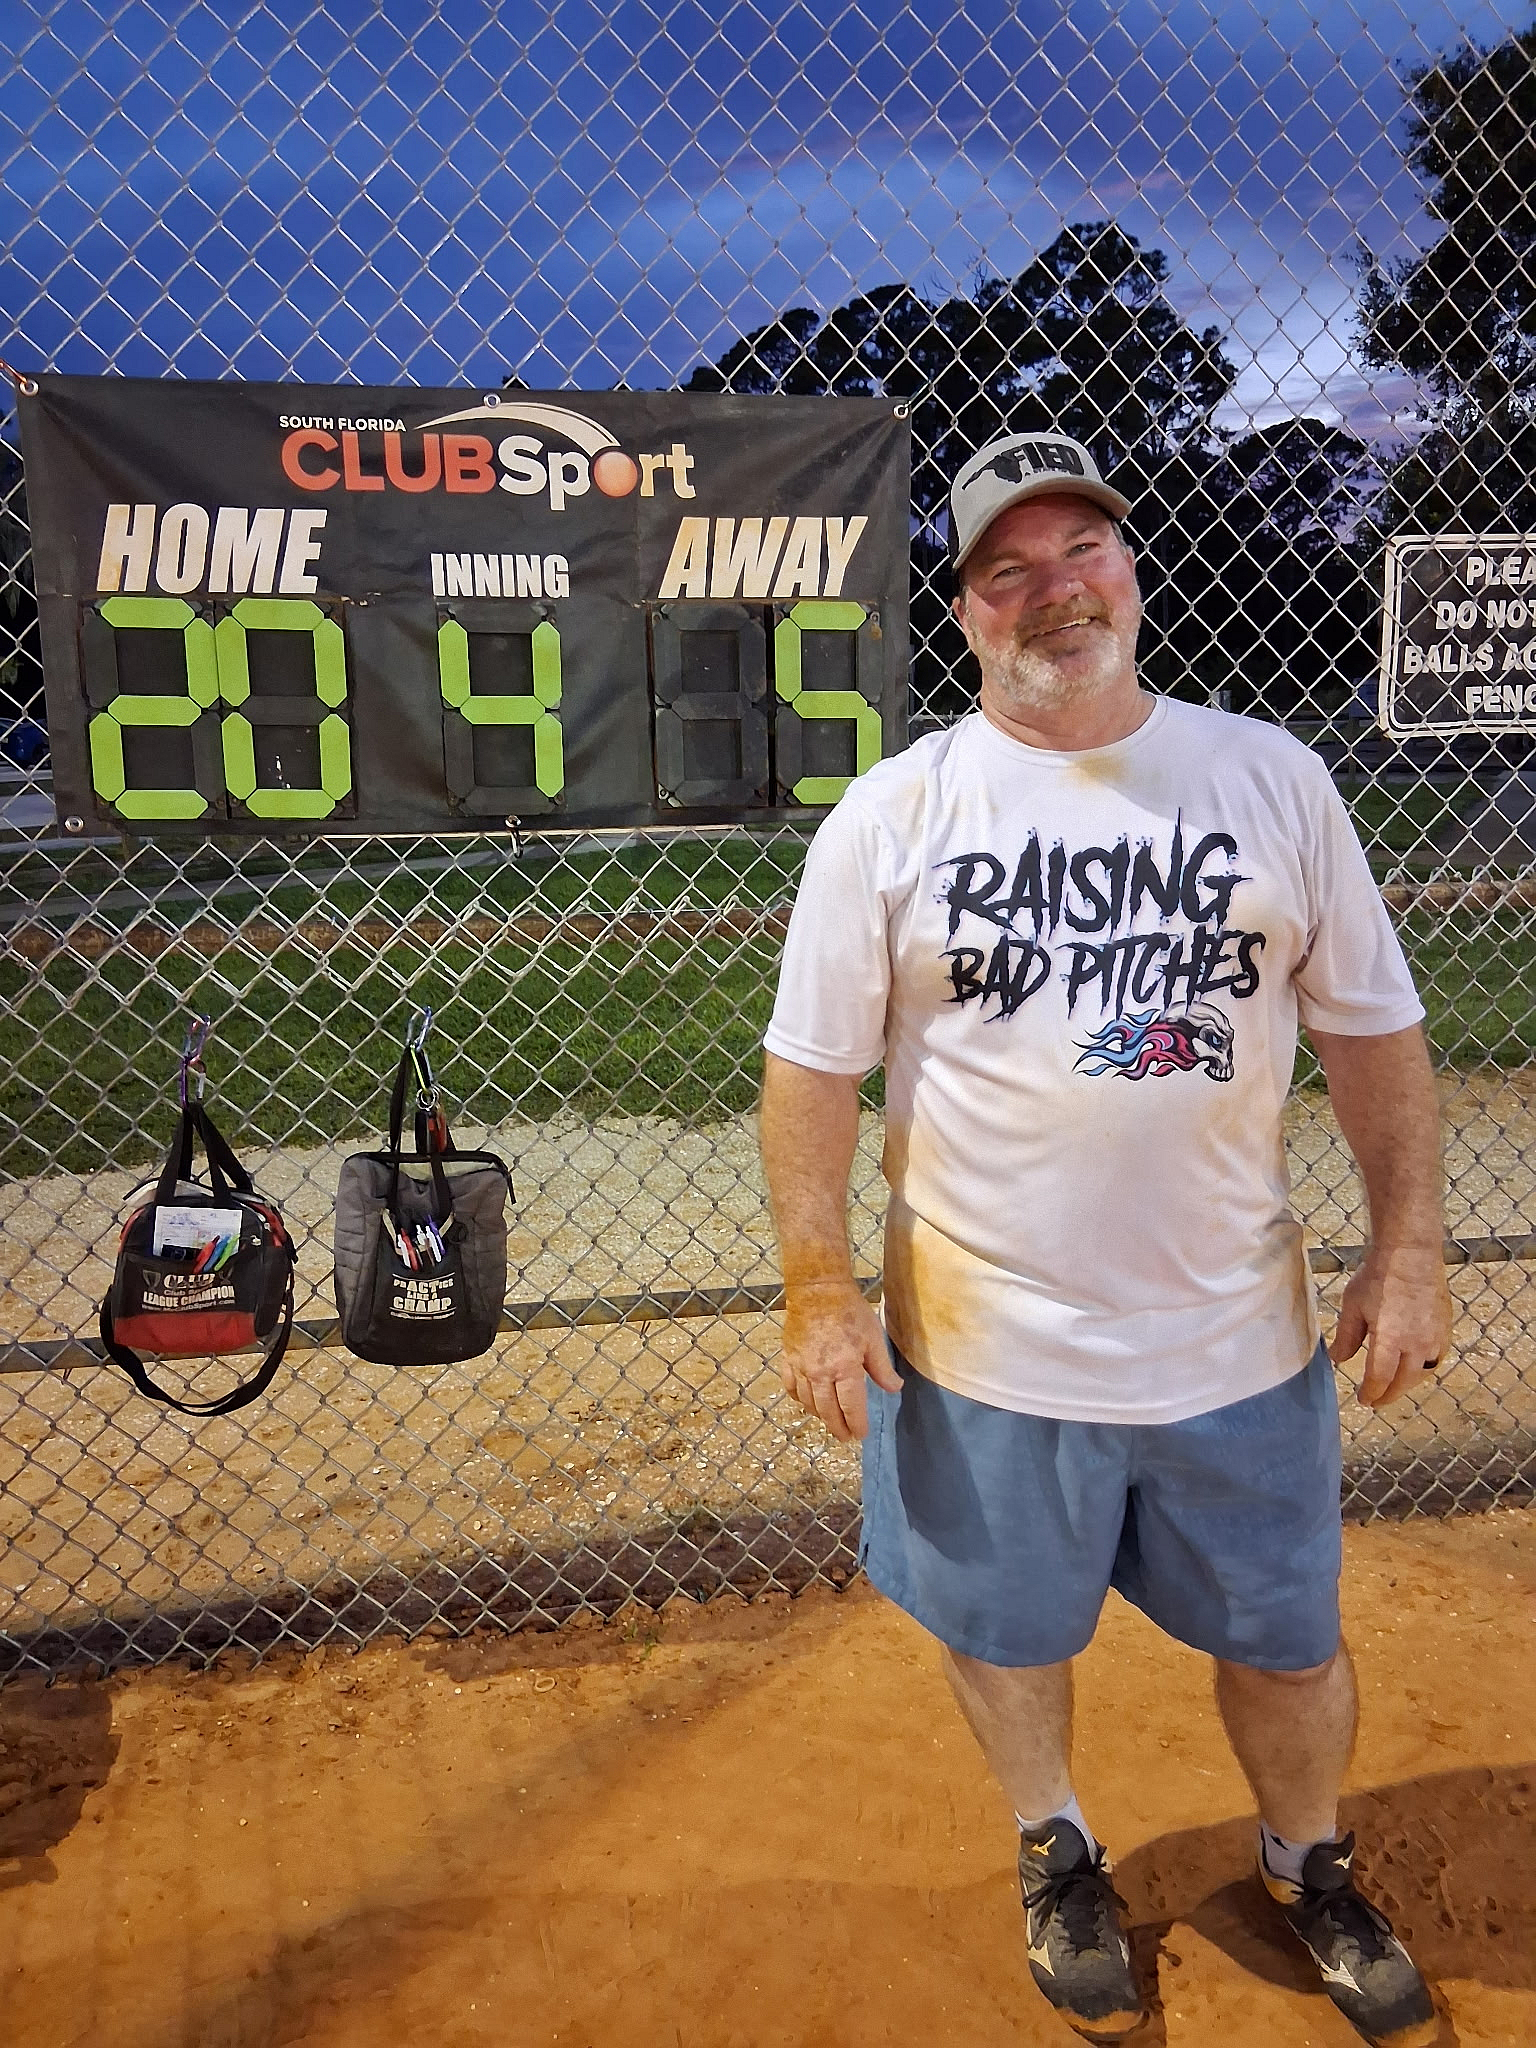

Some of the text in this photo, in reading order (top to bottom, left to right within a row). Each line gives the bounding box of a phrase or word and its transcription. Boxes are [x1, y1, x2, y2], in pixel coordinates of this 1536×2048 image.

[279, 415, 407, 432] SOUTH FLORIDA
[96, 502, 328, 594] HOME
[430, 553, 570, 599] INNING
[658, 516, 869, 599] AWAY
[1435, 600, 1477, 630] DO
[1403, 642, 1494, 674] BALLS
[437, 619, 565, 799] 4
[774, 601, 883, 805] 5
[932, 807, 1253, 949] RAISING
[938, 925, 1266, 1022] BAD PITCHES
[143, 1285, 236, 1308] LEAGUE CHAMPION
[393, 1296, 452, 1313] CHAMP
